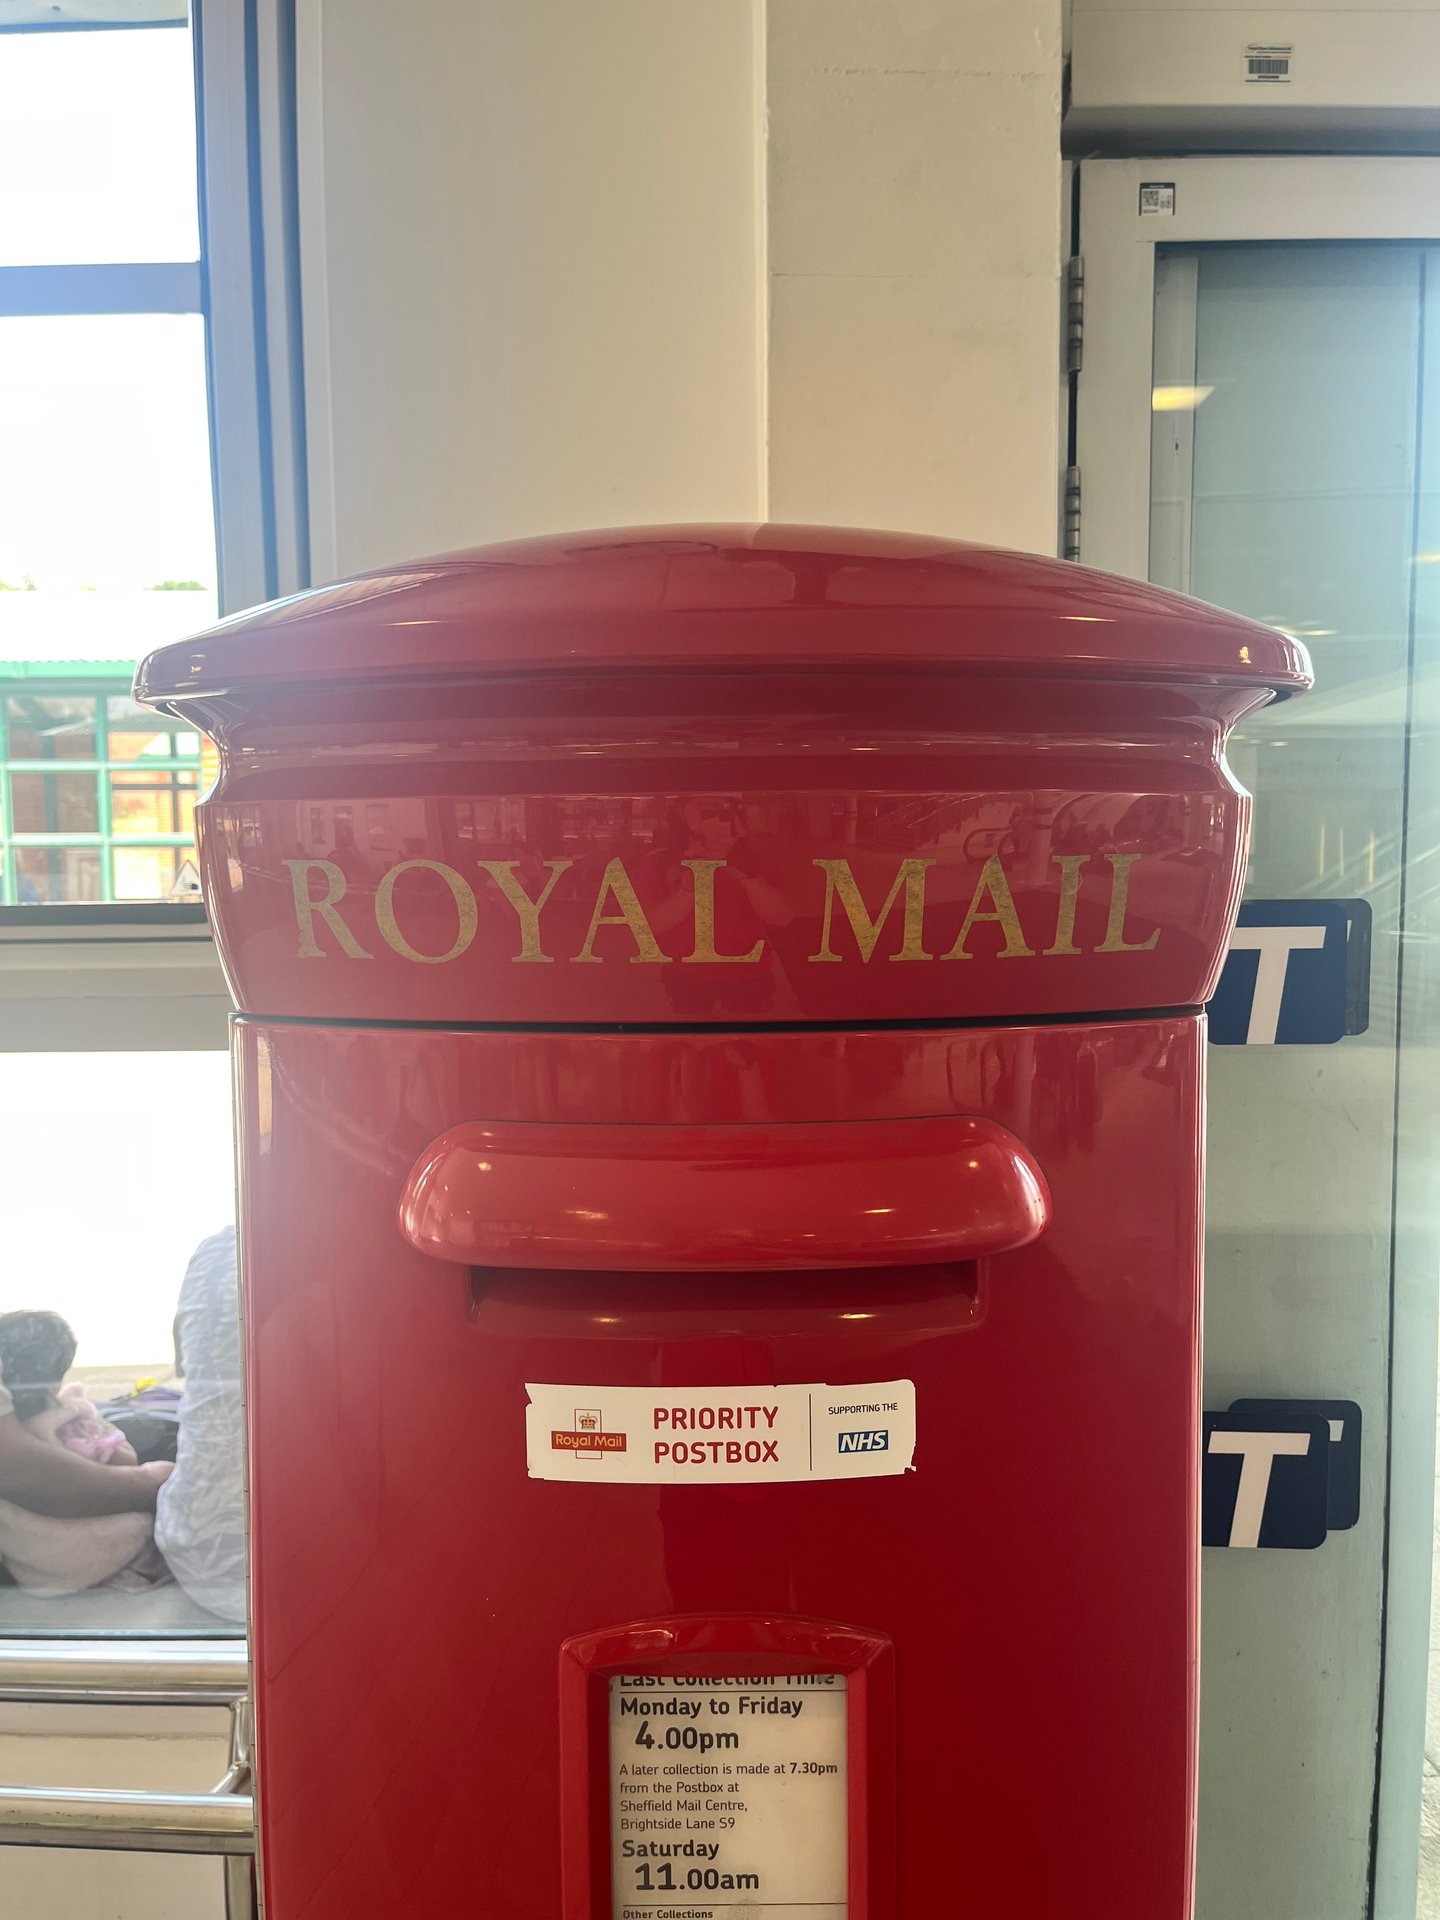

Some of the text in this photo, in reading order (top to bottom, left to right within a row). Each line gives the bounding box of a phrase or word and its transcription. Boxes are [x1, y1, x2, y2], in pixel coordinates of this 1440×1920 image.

[282, 853, 1161, 964] ROYAL MAIL
[1229, 926, 1327, 1045] T
[653, 1406, 779, 1430] PRIORITY
[828, 1402, 898, 1415] SUPPORTING THE
[555, 1433, 622, 1448] Royal Mail
[840, 1431, 887, 1452] NHS
[653, 1440, 779, 1464] POSTBOX
[1208, 1431, 1311, 1548] T
[620, 1696, 803, 1719] Monday to Friday
[635, 1720, 739, 1753] 4.00pm
[619, 1762, 838, 1776] A later collection is made at 7.30pm
[620, 1781, 740, 1793] from the Postbox at
[620, 1799, 748, 1812] Sheffield Mail Centre,
[621, 1817, 736, 1831] Brightside Lane S9
[622, 1839, 720, 1860] Saturday
[635, 1862, 760, 1890] 11.00am
[623, 1909, 713, 1919] Other Collections
